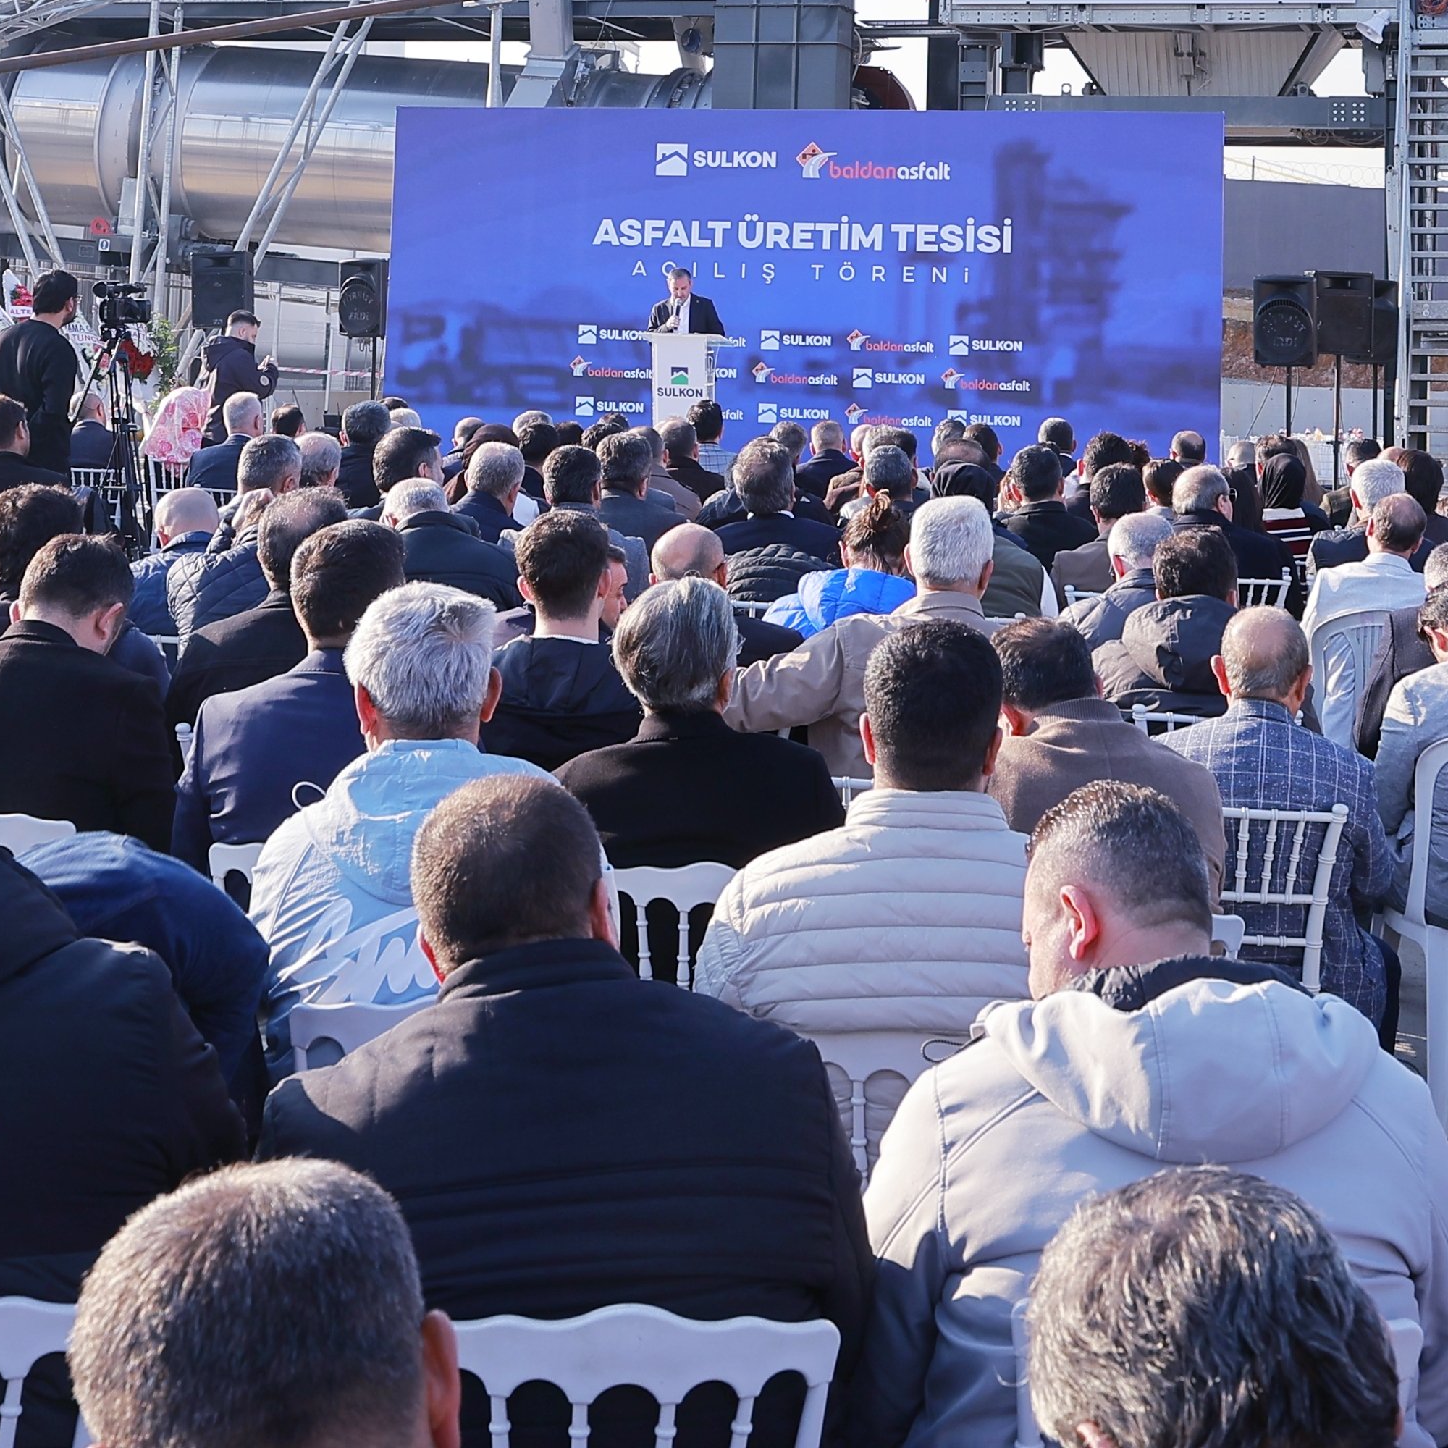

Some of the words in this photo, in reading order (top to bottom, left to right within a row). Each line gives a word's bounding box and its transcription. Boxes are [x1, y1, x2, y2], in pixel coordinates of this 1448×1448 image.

[693, 150, 778, 169] SULKON
[829, 160, 951, 181] baldanasfalt
[592, 218, 733, 249] ASFALT
[737, 213, 883, 251] ÜRETİM
[890, 217, 1013, 254] TESİSİ
[782, 334, 832, 346] SULKON
[865, 340, 934, 353] baldanasfalt
[971, 340, 1023, 352] SULKON
[770, 373, 838, 386] baldanasfalt
[874, 372, 925, 385] SULKON
[657, 387, 703, 398] SULKON
[960, 380, 1030, 392] baldanasfalt
[596, 401, 644, 413] SULKON
[780, 407, 829, 420] SULKON
[969, 414, 1021, 427] SULKON
